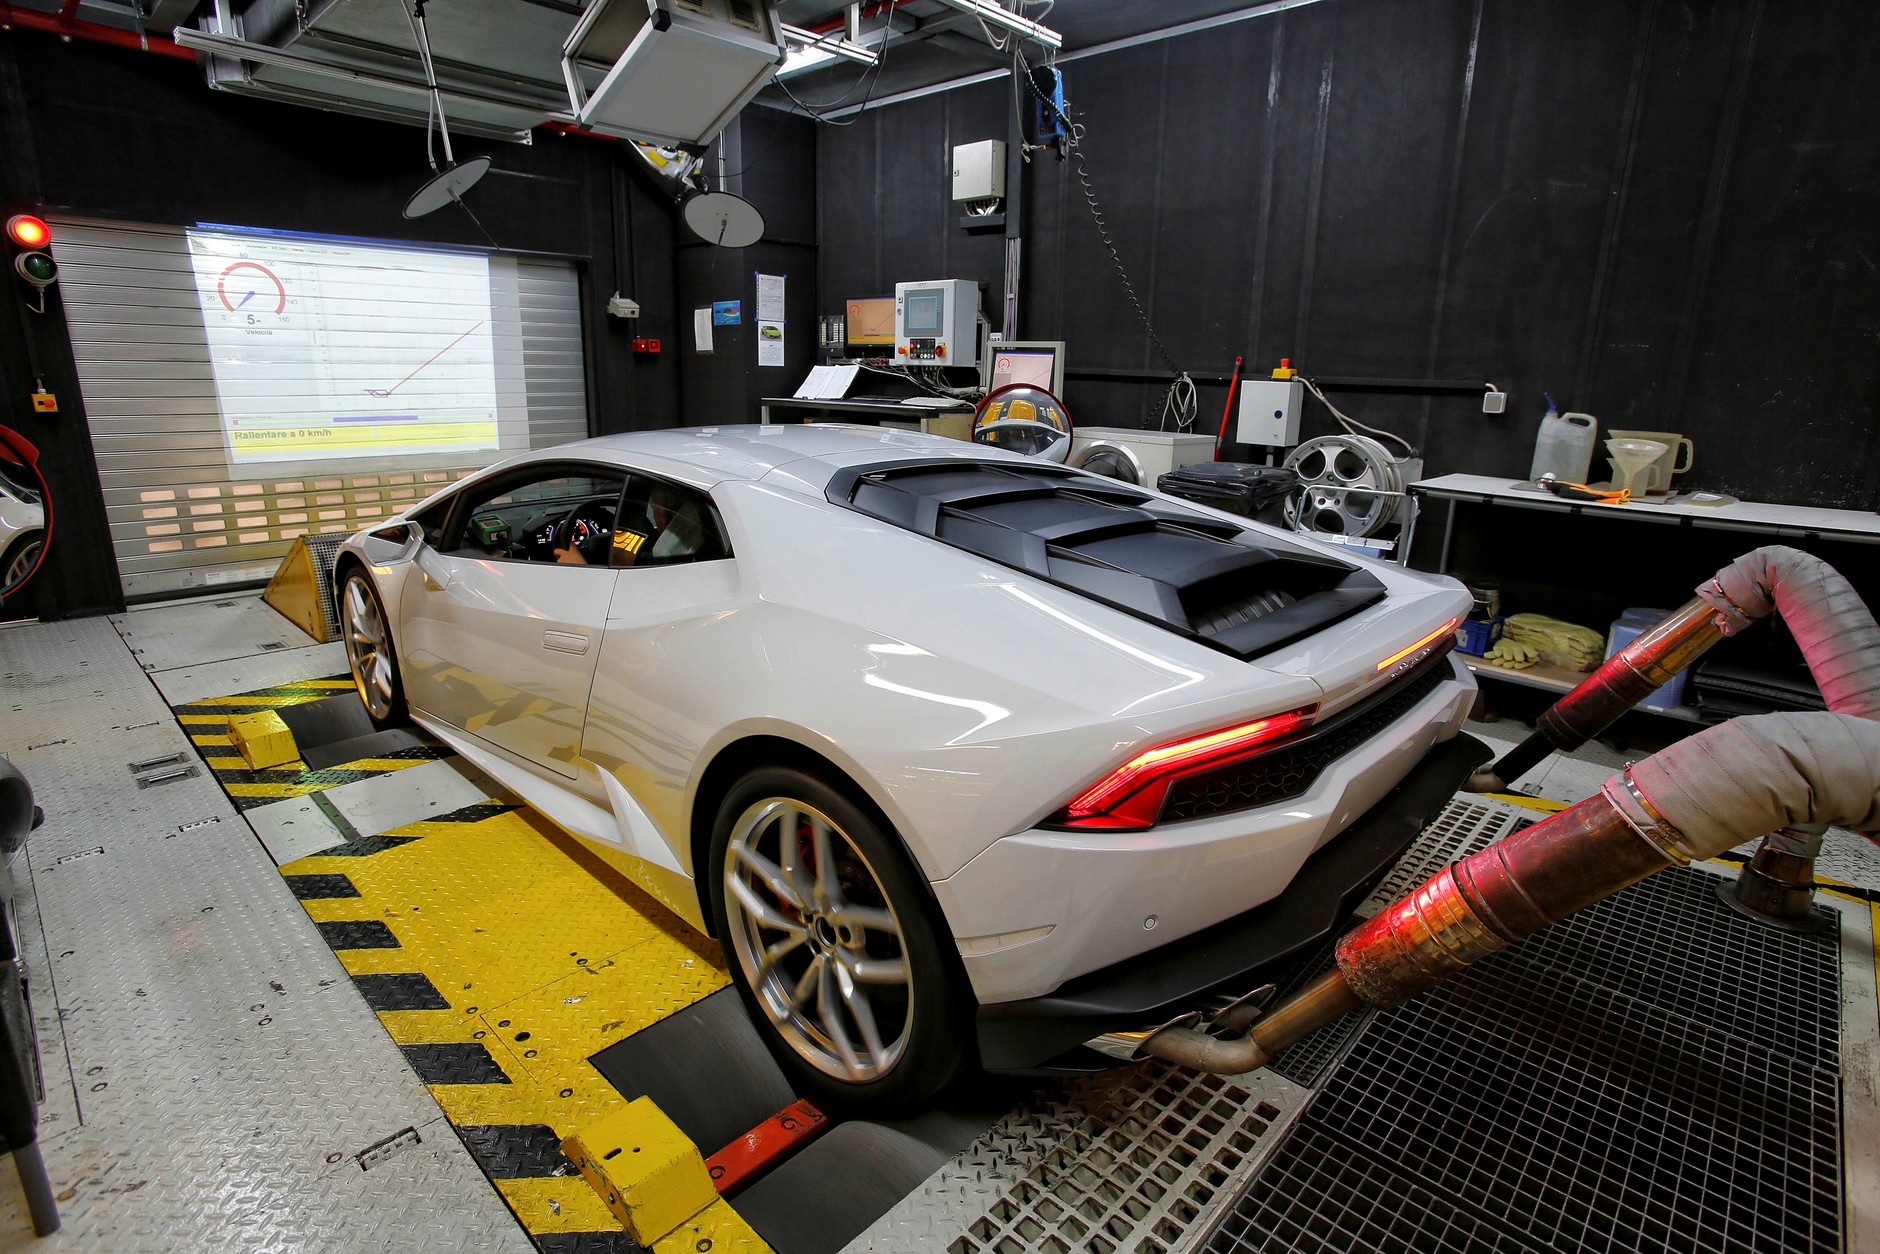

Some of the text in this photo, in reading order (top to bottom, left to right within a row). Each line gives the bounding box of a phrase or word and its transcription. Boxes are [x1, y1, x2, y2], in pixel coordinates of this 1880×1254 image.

[234, 430, 287, 440] Rallentare
[298, 429, 305, 437] 0
[307, 429, 332, 437] km/h
